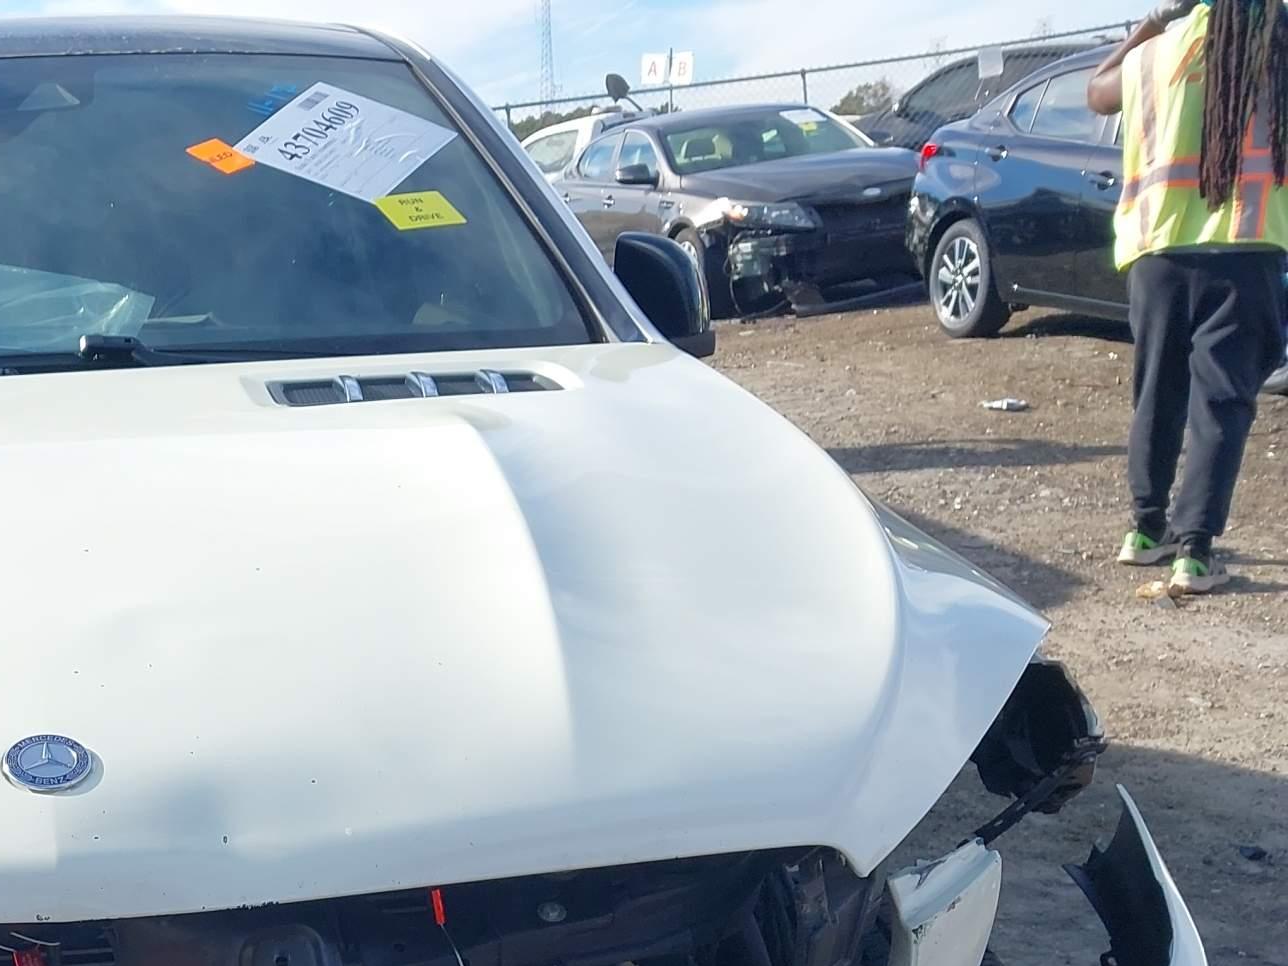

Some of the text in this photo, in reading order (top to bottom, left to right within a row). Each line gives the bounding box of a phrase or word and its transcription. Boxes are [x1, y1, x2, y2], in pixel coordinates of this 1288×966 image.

[647, 60, 657, 77] A
[678, 61, 688, 77] B
[277, 101, 360, 161] 43704609
[408, 213, 444, 222] DRIVE
[17, 735, 74, 749] MERCEDES
[34, 776, 66, 786] BENZ
